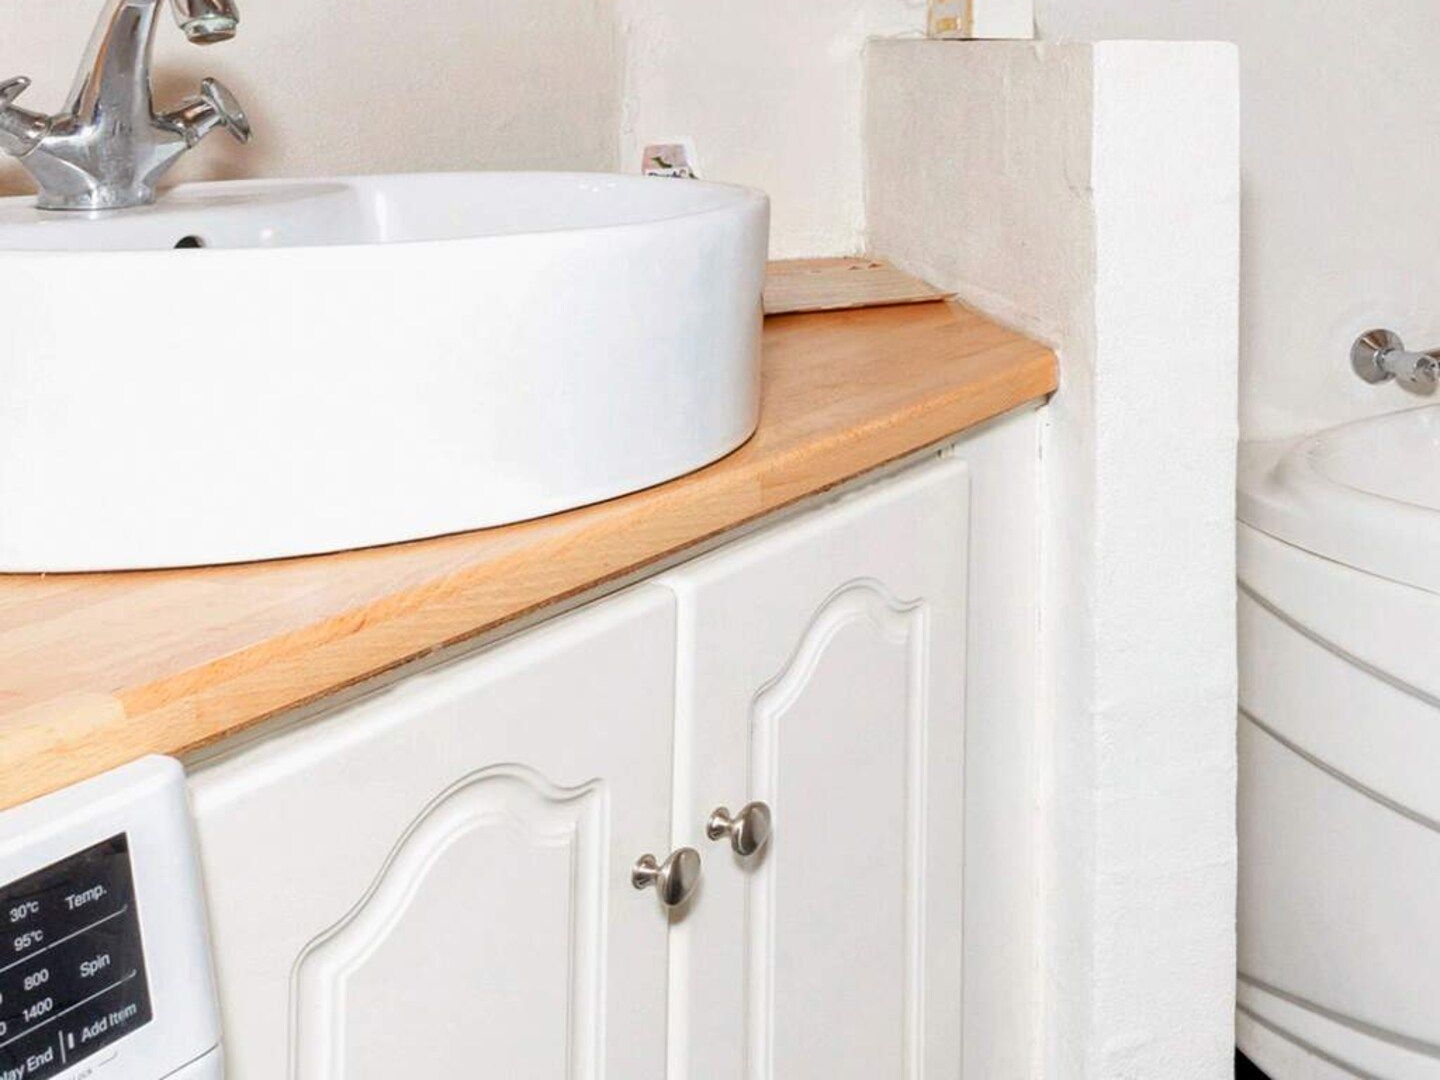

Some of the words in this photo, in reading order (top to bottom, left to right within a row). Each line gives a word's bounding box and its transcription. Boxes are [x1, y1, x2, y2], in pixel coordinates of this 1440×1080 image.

[65, 884, 108, 911] Temp.
[23, 968, 49, 991] 800
[80, 953, 111, 979] Spin
[22, 997, 53, 1022] 1400
[82, 1016, 108, 1042] Add
[26, 1046, 54, 1072] End
